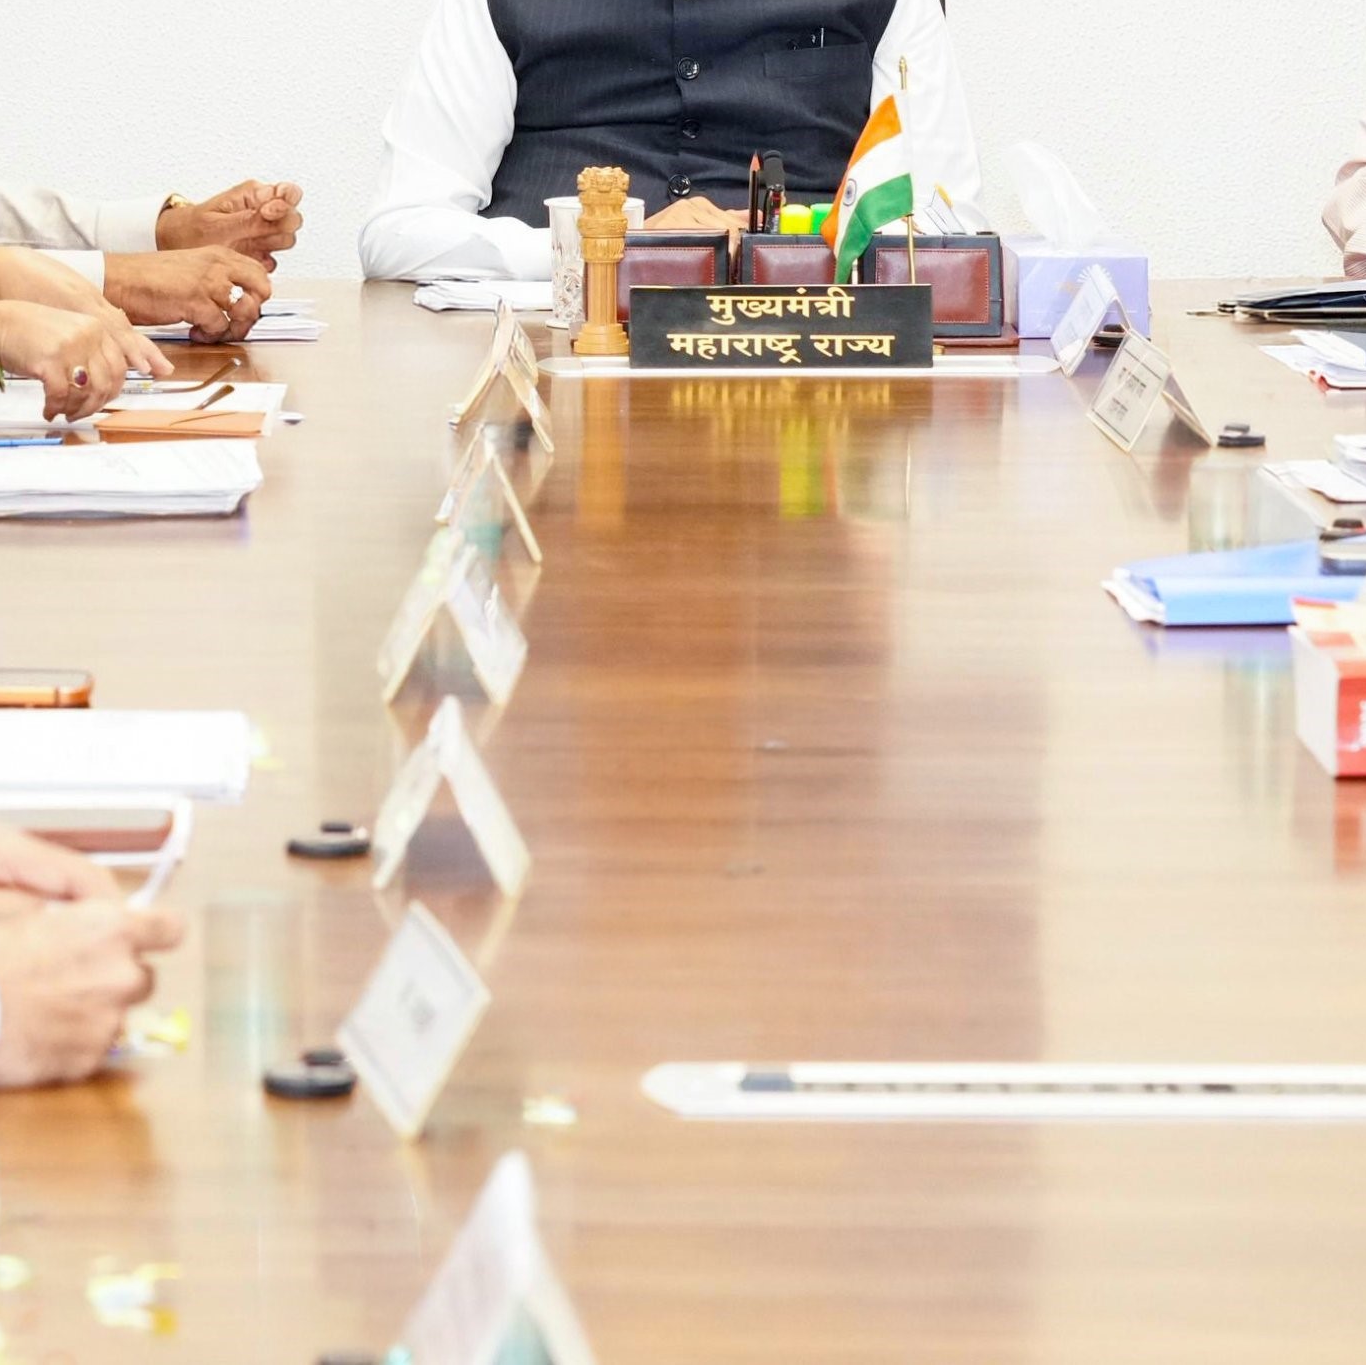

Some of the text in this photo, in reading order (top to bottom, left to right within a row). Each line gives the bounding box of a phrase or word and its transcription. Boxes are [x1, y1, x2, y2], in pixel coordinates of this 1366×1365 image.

[706, 286, 855, 326] मुख्यमंत्री
[666, 333, 896, 364] महाराष्ट्र राज्य
